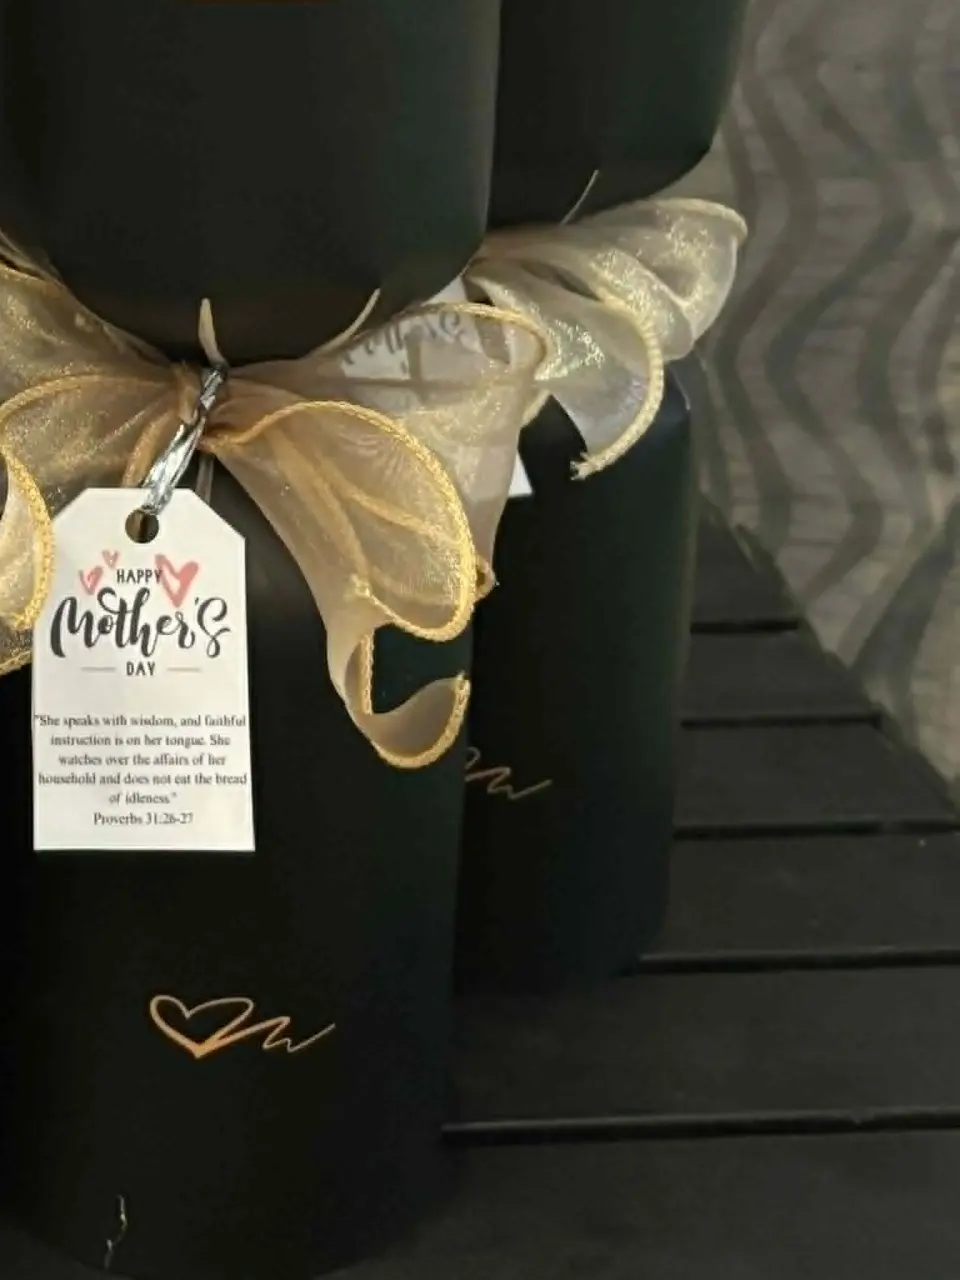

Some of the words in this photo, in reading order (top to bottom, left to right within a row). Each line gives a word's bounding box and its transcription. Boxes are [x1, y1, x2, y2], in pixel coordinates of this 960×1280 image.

[116, 568, 161, 585] HAPPY
[126, 662, 157, 677] DAY
[63, 714, 100, 730] speaks
[102, 714, 127, 726] with
[130, 714, 177, 728] wisdom,
[181, 714, 201, 726] and
[204, 714, 246, 726] faithful
[51, 733, 111, 746] instruction
[115, 733, 124, 746] is
[126, 736, 141, 746] on
[144, 733, 163, 746] her
[209, 733, 231, 746] She
[58, 753, 102, 766] watches
[105, 756, 129, 766] over
[132, 752, 150, 766] the
[153, 752, 189, 766] affairs
[192, 752, 206, 766] of
[208, 752, 227, 766] her
[38, 772, 96, 785] household
[99, 772, 121, 784] and
[123, 772, 149, 784] does
[152, 774, 171, 784] not
[174, 773, 191, 784] eat
[194, 772, 212, 784] the
[215, 771, 247, 784] bread
[108, 791, 122, 804] of
[93, 811, 143, 825] Proverbs
